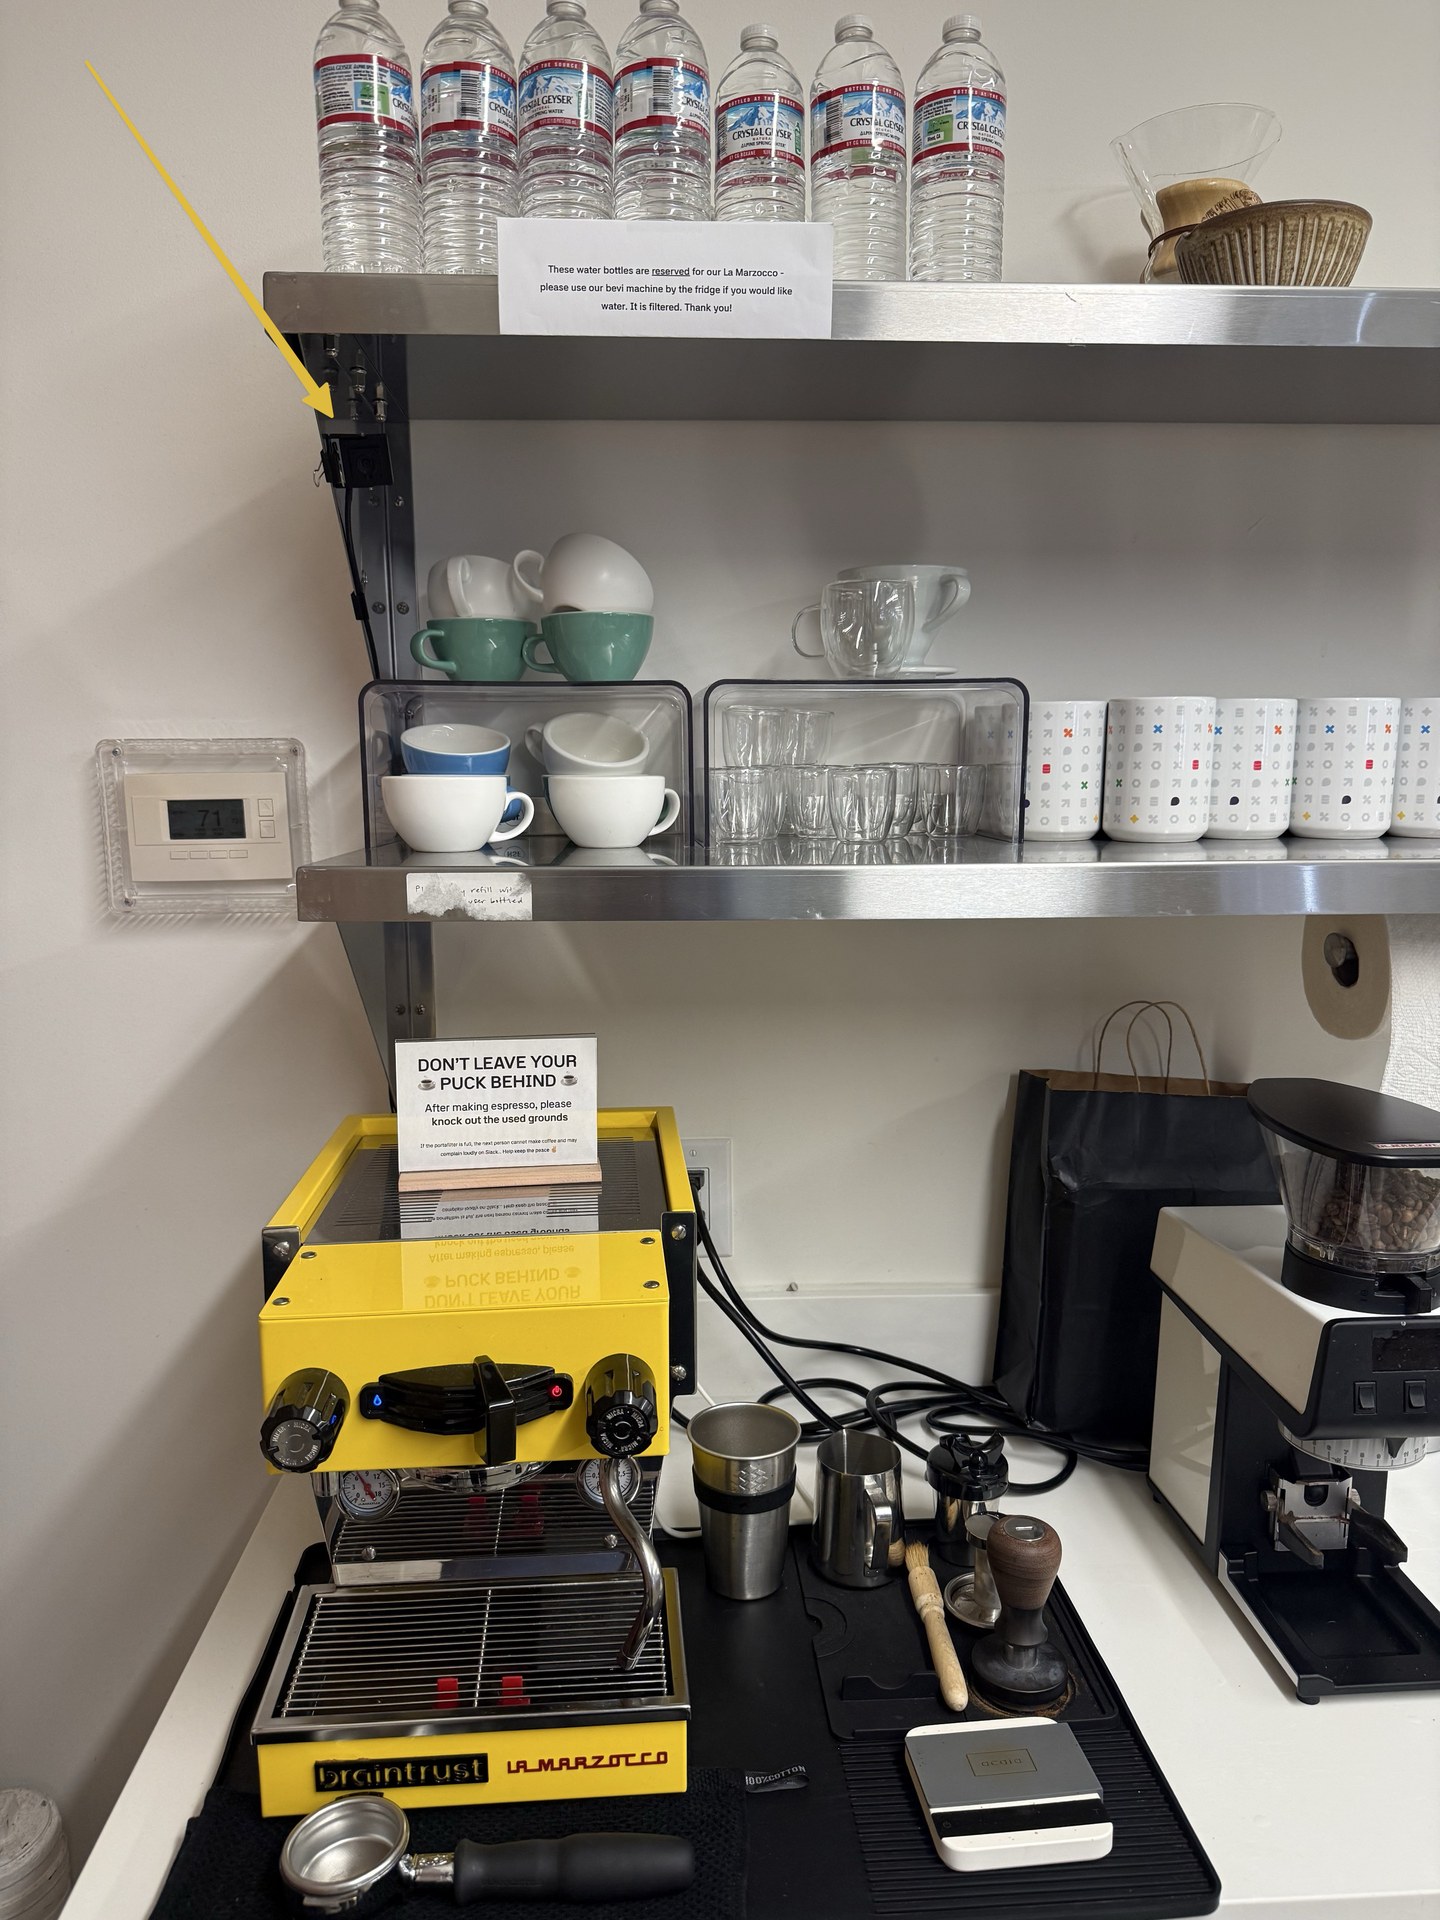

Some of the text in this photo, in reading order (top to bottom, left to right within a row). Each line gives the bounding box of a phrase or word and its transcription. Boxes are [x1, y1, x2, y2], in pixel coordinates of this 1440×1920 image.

[541, 94, 573, 105] GEYSER
[728, 97, 751, 108] BOTTLED
[957, 120, 989, 133] CRSTAL
[732, 127, 764, 141] CRYSTAL
[548, 265, 574, 274] These
[576, 266, 601, 274] water
[603, 266, 633, 275] bottles
[651, 267, 690, 276] reserved
[692, 267, 704, 276] for
[723, 268, 733, 276] La
[735, 268, 778, 277] Marzocco
[540, 283, 569, 293] please
[571, 284, 587, 292] use
[605, 284, 624, 292] bevi
[626, 284, 664, 293] machine
[665, 285, 676, 295] by
[678, 285, 693, 294] the
[695, 285, 721, 296] fridge
[722, 285, 729, 294] if
[730, 287, 747, 296] you
[749, 286, 775, 295] would
[777, 286, 793, 295] like
[601, 302, 732, 314] water. It is filtered. Thank you!
[197, 809, 220, 827] 71
[418, 1054, 577, 1072] DON'T LEAVE YOUR
[440, 1074, 557, 1091] PUCK BEHIND
[424, 1099, 572, 1113] After making espresso, please
[431, 1112, 568, 1126] knock out the used grounds
[606, 1408, 625, 1420] MICRA
[631, 1412, 645, 1429] MICRA
[507, 1751, 668, 1774] LA MARZOCCO
[319, 1758, 483, 1789] braintrust
